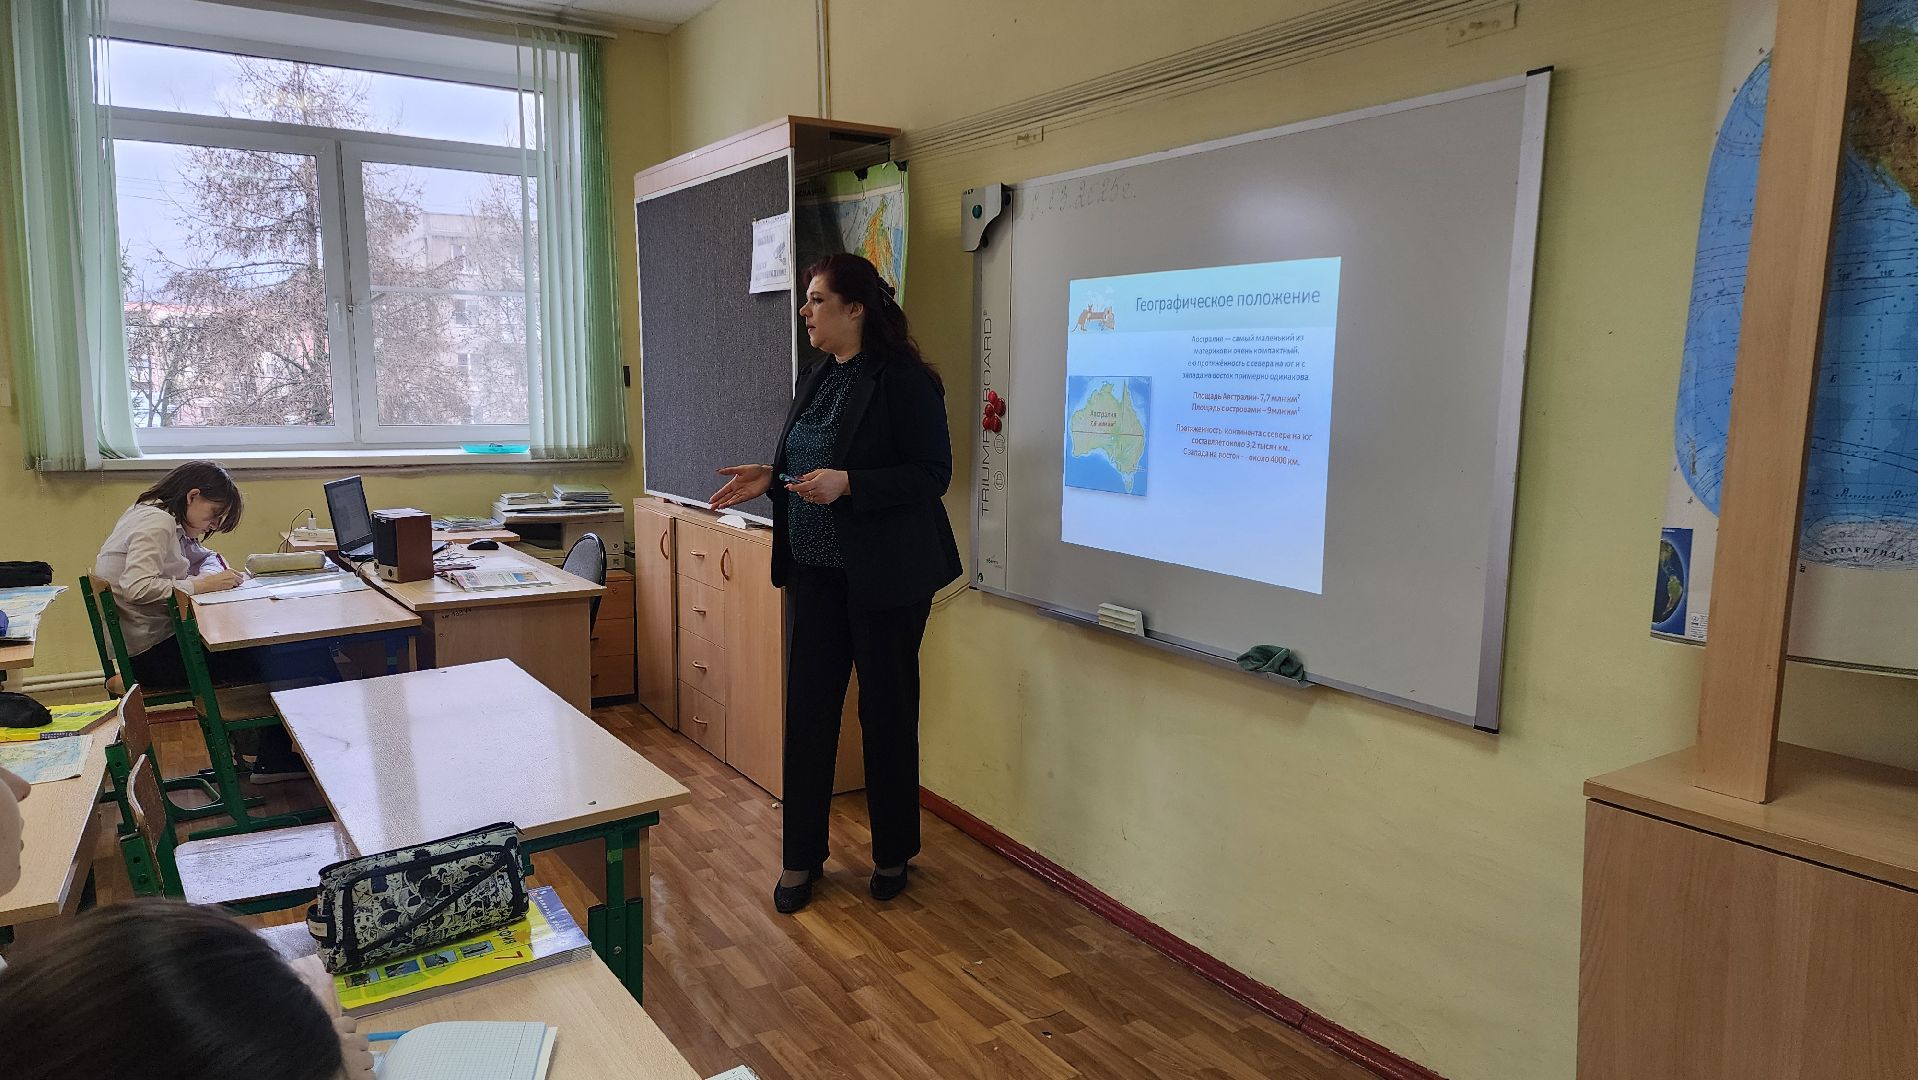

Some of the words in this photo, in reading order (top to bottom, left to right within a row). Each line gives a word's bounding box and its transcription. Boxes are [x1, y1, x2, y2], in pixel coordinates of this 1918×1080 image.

[1136, 293, 1234, 314] Географическое
[1237, 289, 1321, 307] положение
[1191, 335, 1224, 344] Австралия
[1232, 334, 1254, 342] самый
[1256, 333, 1295, 342] маленький
[1284, 360, 1294, 368] юг
[1235, 373, 1269, 382] примерно
[1193, 391, 1221, 401] Площадь
[1191, 402, 1220, 413] Площадь
[1267, 431, 1291, 440] севера
[1246, 440, 1256, 450] 3,2
[1257, 443, 1277, 451] тысяч
[1218, 452, 1240, 460] восток
[1248, 454, 1269, 463] около
[1270, 455, 1287, 465] 4000
[981, 413, 992, 517] TRIUMP
[1823, 545, 1905, 562] АНТАРКТИДА
[493, 950, 524, 960] 7
